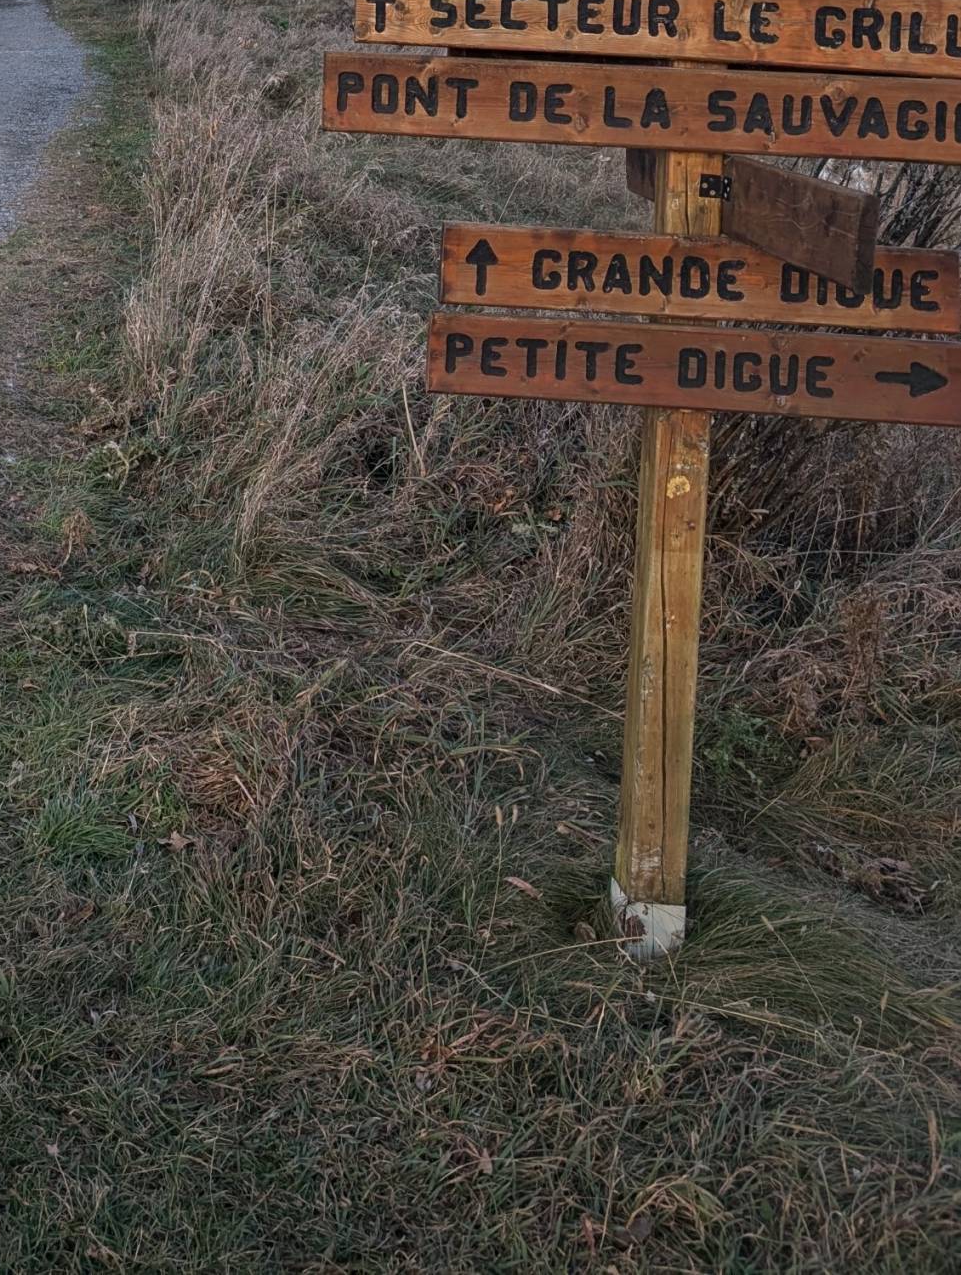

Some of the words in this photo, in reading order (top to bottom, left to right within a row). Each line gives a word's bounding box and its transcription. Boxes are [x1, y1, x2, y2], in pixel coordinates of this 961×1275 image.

[713, 0, 780, 44] LE
[336, 71, 479, 118] PONT
[508, 80, 573, 124] DE
[603, 85, 671, 130] LA
[707, 89, 961, 144] SAUVAGI
[531, 248, 746, 302] GRANDE
[444, 332, 644, 386] PETITE
[677, 347, 836, 399] DIGUE
